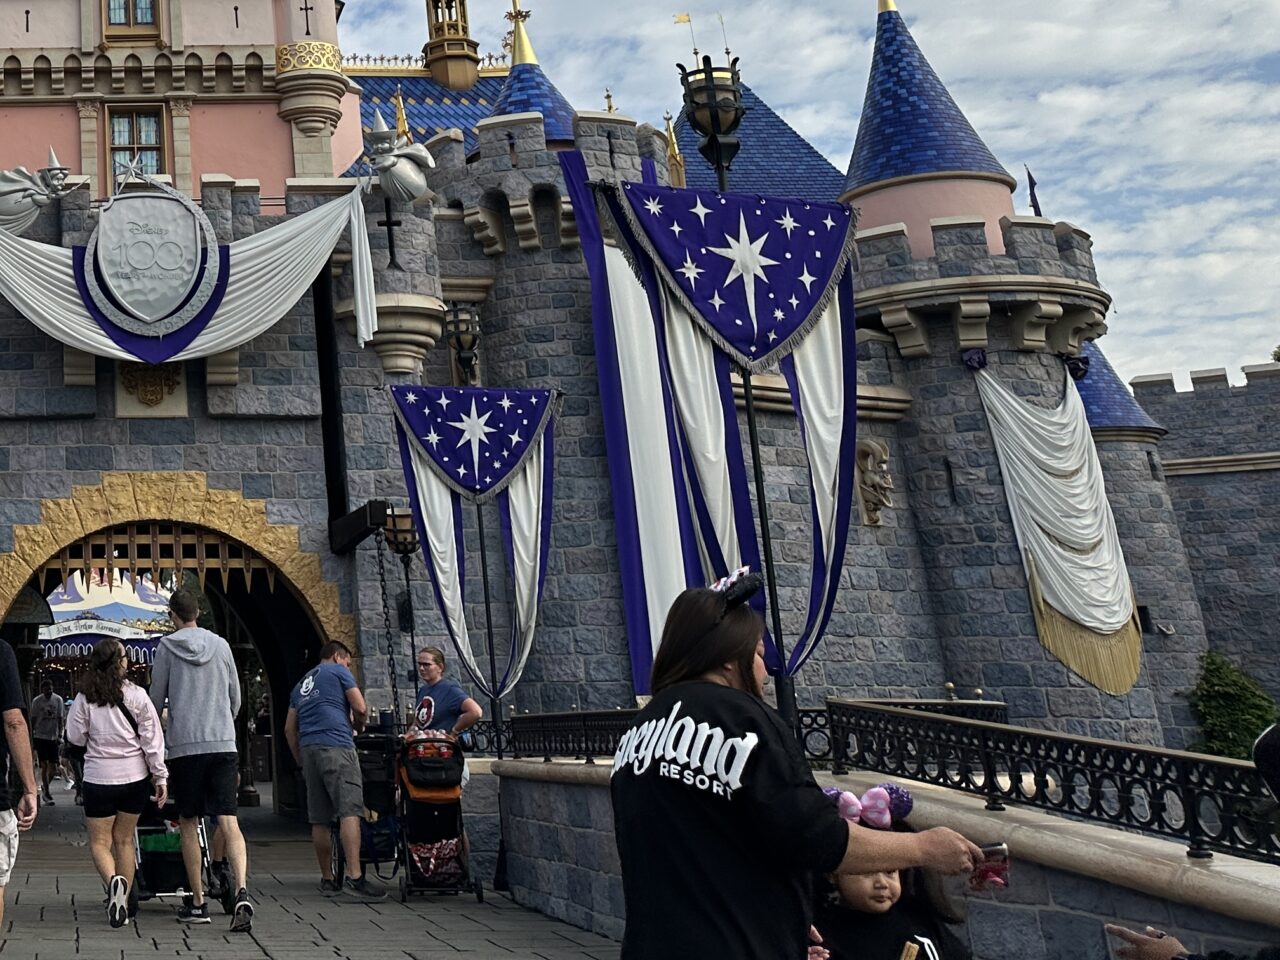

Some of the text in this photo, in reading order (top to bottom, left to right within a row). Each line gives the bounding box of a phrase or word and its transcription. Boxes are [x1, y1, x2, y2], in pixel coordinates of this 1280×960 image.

[125, 221, 170, 239] Disney
[112, 241, 186, 271] 100
[610, 700, 759, 791] neyland
[659, 761, 734, 801] RESORT
